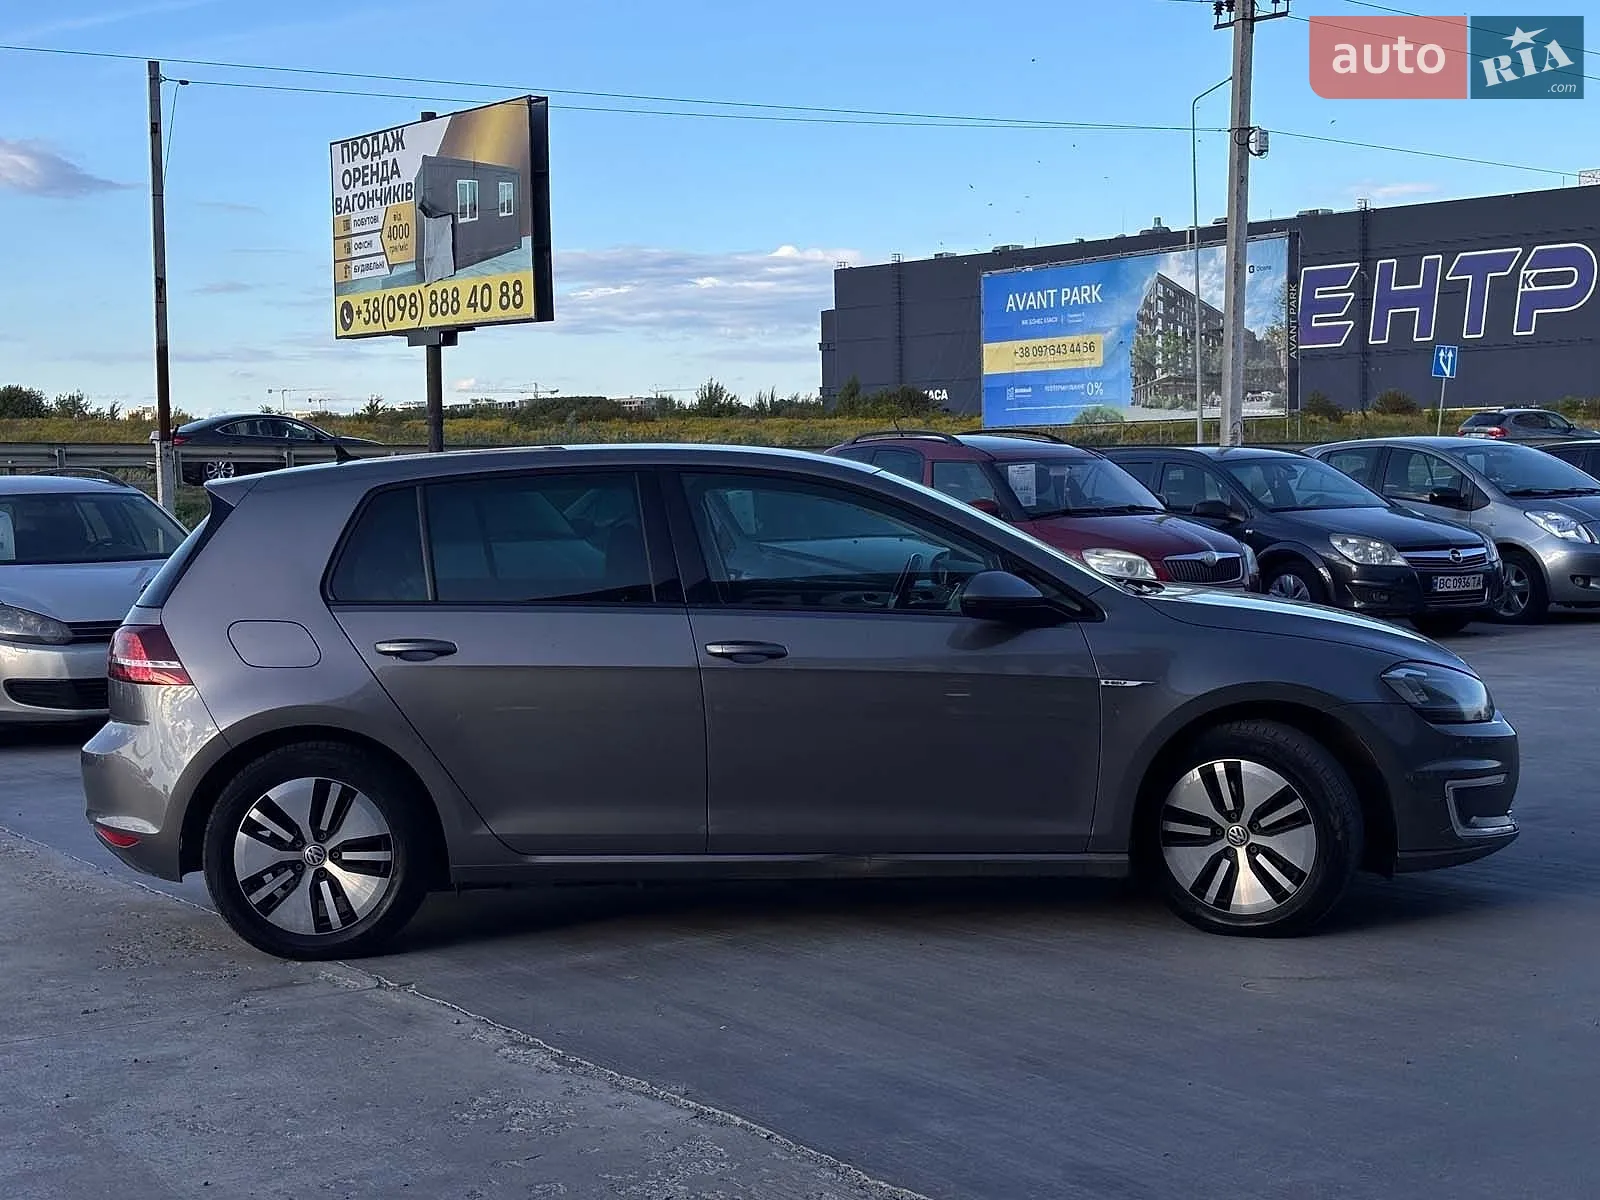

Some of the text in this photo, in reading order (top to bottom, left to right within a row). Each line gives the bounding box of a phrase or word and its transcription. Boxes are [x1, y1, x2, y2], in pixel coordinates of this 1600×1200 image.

[340, 128, 406, 165] ПРОДАЖ
[341, 158, 401, 191] ОРЕНДА
[335, 182, 413, 216] ВАГОНЧИКІВ
[387, 223, 410, 241] 4000
[355, 279, 524, 331] +38(098) 888 40 88
[1005, 283, 1104, 313] AVANT PARK
[1289, 283, 1297, 359] AVANT PARK
[1086, 382, 1104, 397] 0%
